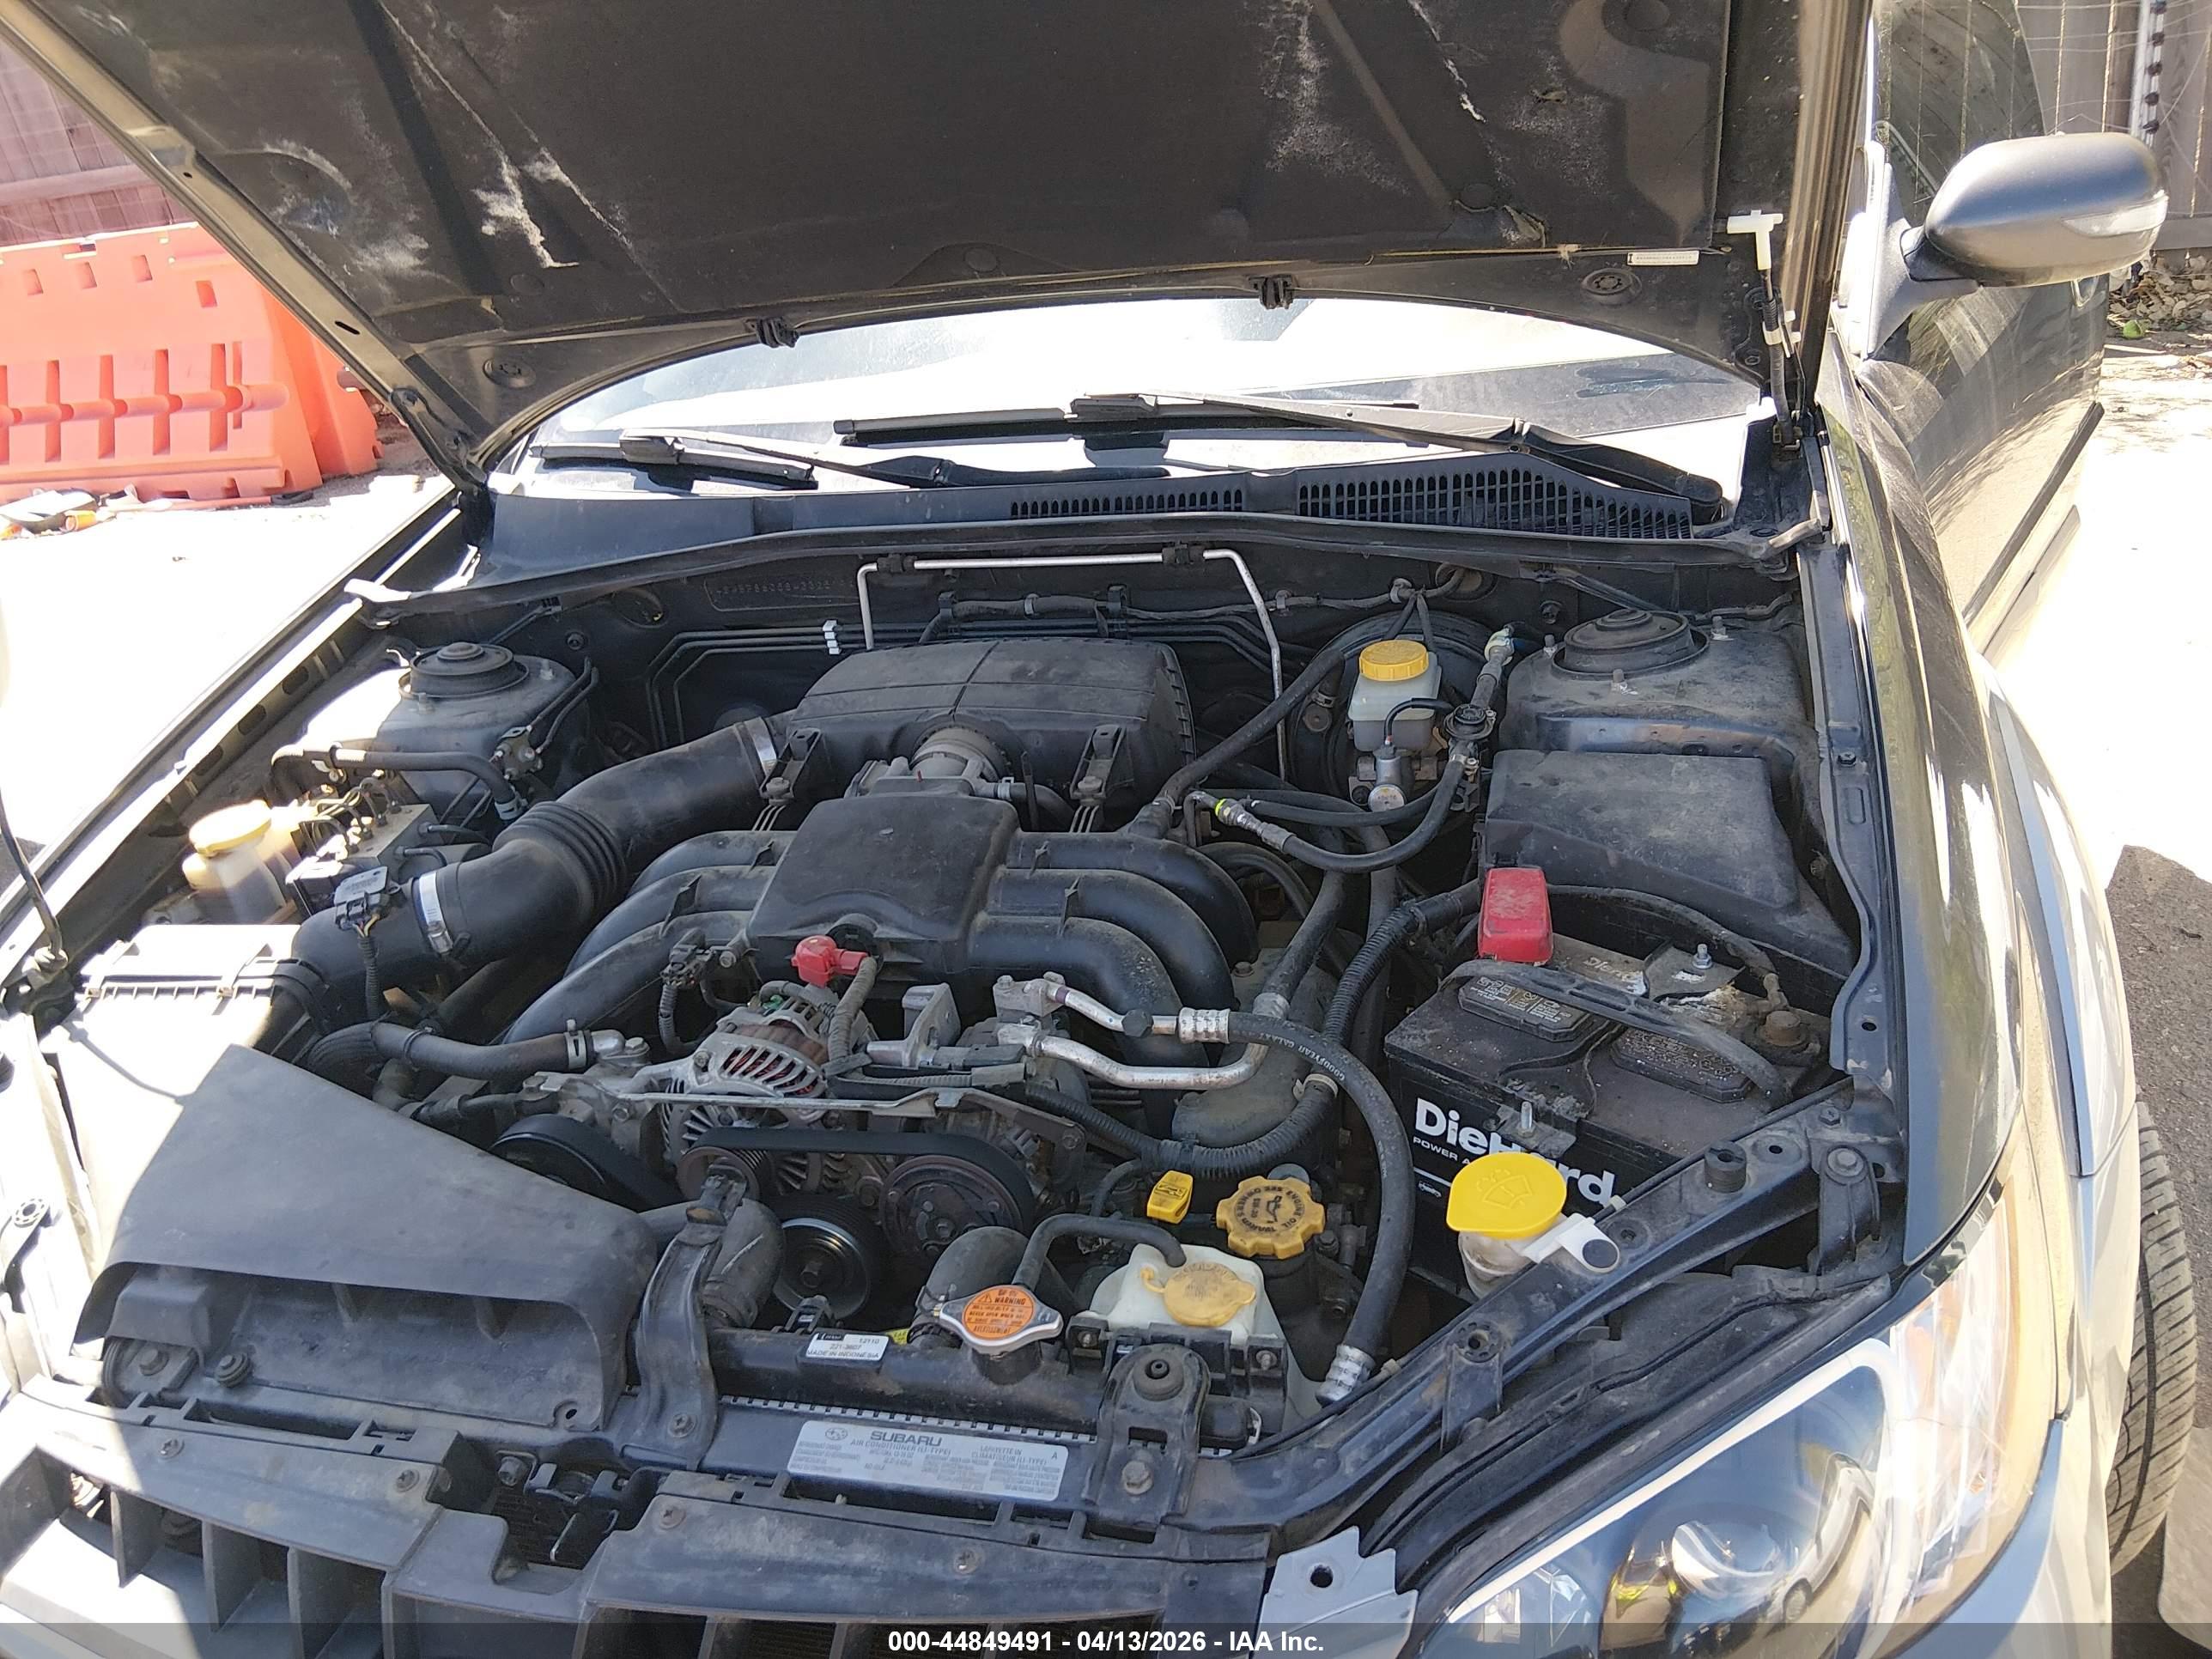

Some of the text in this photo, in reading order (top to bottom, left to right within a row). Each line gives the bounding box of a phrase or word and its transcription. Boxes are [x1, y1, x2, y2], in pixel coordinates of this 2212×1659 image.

[1297, 1045, 1346, 1081] GOODYEAR
[1413, 1136, 1458, 1161] POWER
[1281, 1189, 1302, 1228] ENGINE OIL
[994, 1297, 1026, 1305] WARNING
[865, 1440, 917, 1452] CONDITIONER
[870, 1430, 943, 1447] SUBARU
[1051, 1451, 1058, 1460] A
